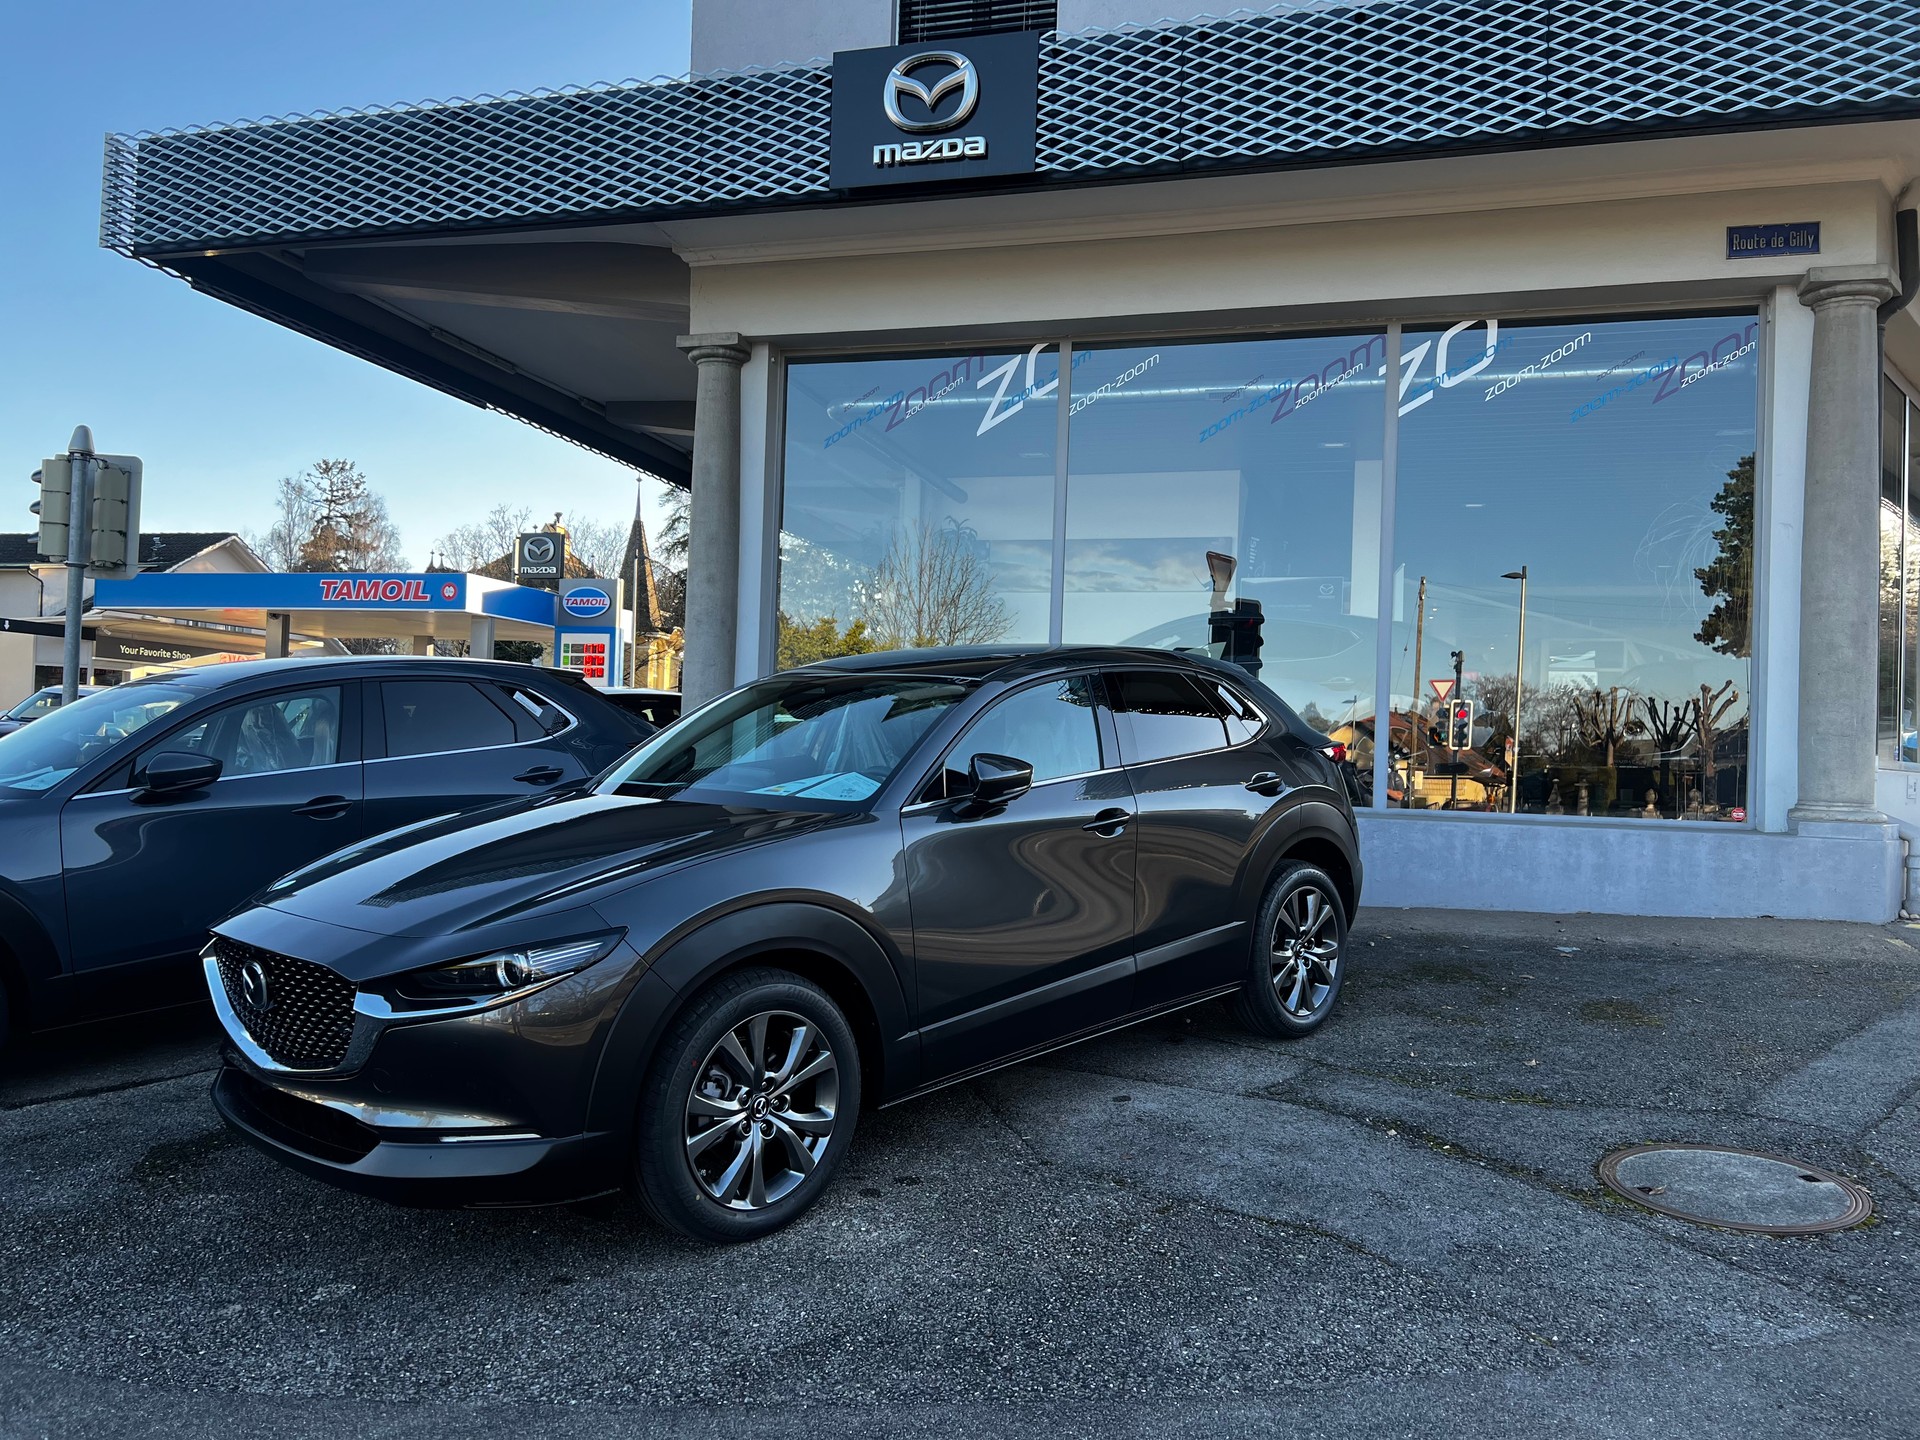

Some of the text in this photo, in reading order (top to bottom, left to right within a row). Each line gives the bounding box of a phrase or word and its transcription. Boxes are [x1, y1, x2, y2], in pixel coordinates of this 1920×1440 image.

[1733, 230, 1814, 250] Route de Gilly
[1069, 353, 1160, 416] zoom-zoom
[1485, 332, 1591, 402] zoom-zoom
[844, 386, 880, 412] zoom-zoom
[906, 376, 964, 419] zoom-zoom
[1223, 374, 1264, 403] zoom-zoom
[1295, 362, 1364, 410] zoom-zoom
[824, 390, 904, 449] zoom-zoom
[1200, 379, 1292, 443] zoom-zoom
[320, 579, 430, 601] TAMOIL
[564, 598, 608, 606] TAMOIL
[120, 645, 139, 655] Your
[140, 647, 171, 659] Favorite
